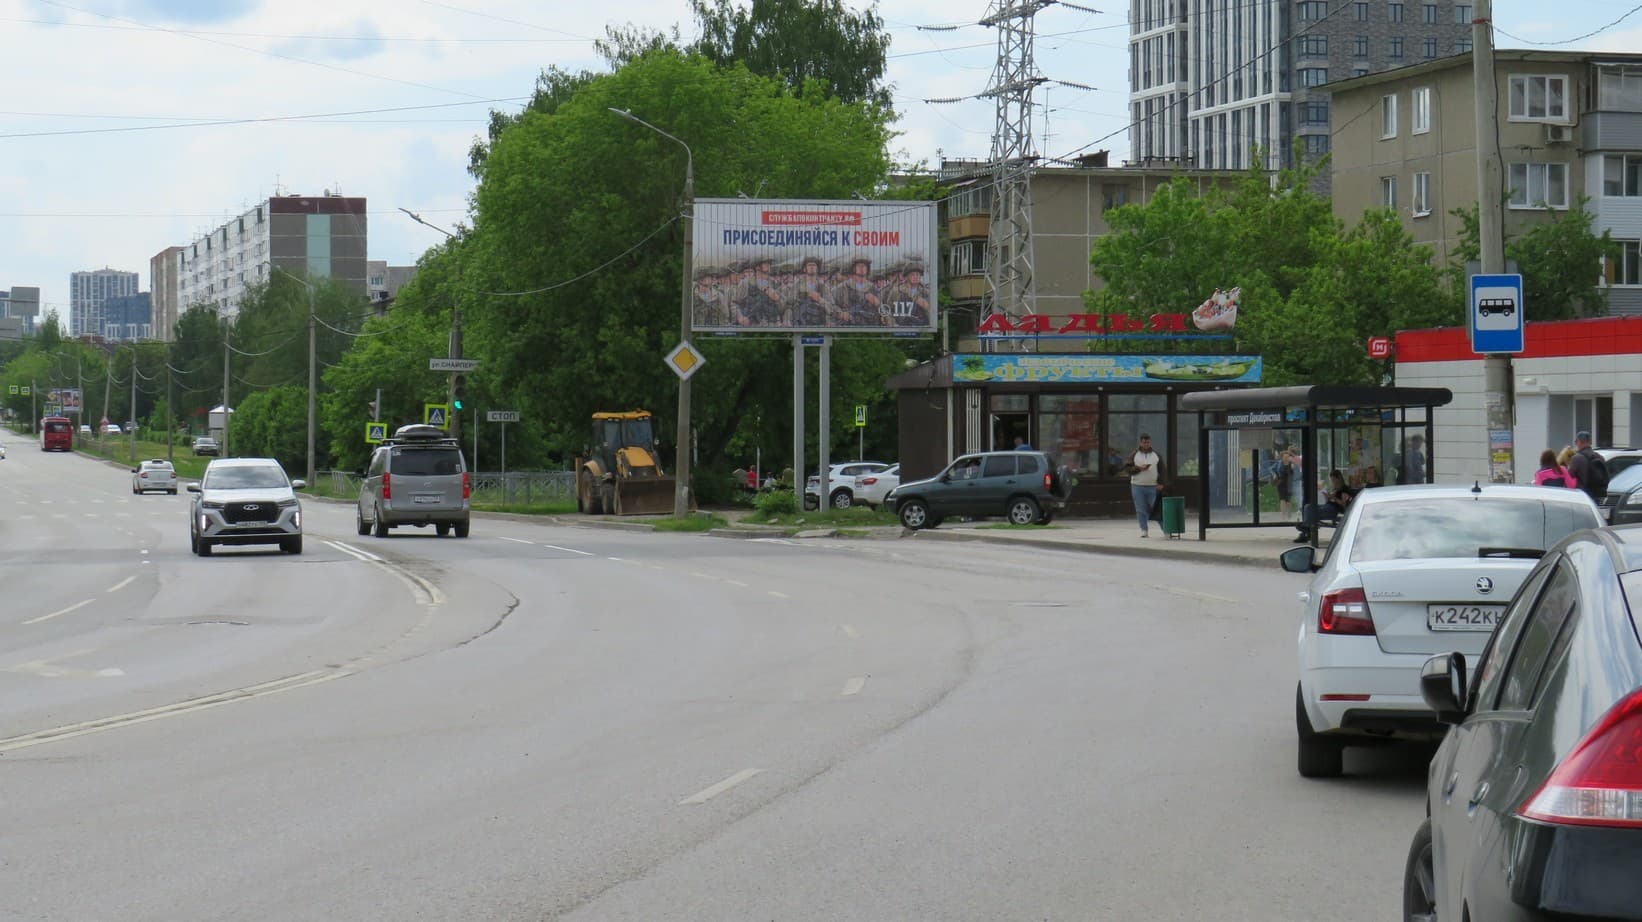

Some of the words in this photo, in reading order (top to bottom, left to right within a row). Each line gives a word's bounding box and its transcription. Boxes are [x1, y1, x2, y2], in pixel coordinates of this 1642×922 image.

[723, 227, 838, 247] ПРИСОЕДИНЯЙСЯ
[841, 230, 850, 246] К
[853, 231, 900, 247] СВОИМ
[893, 301, 914, 317] 117
